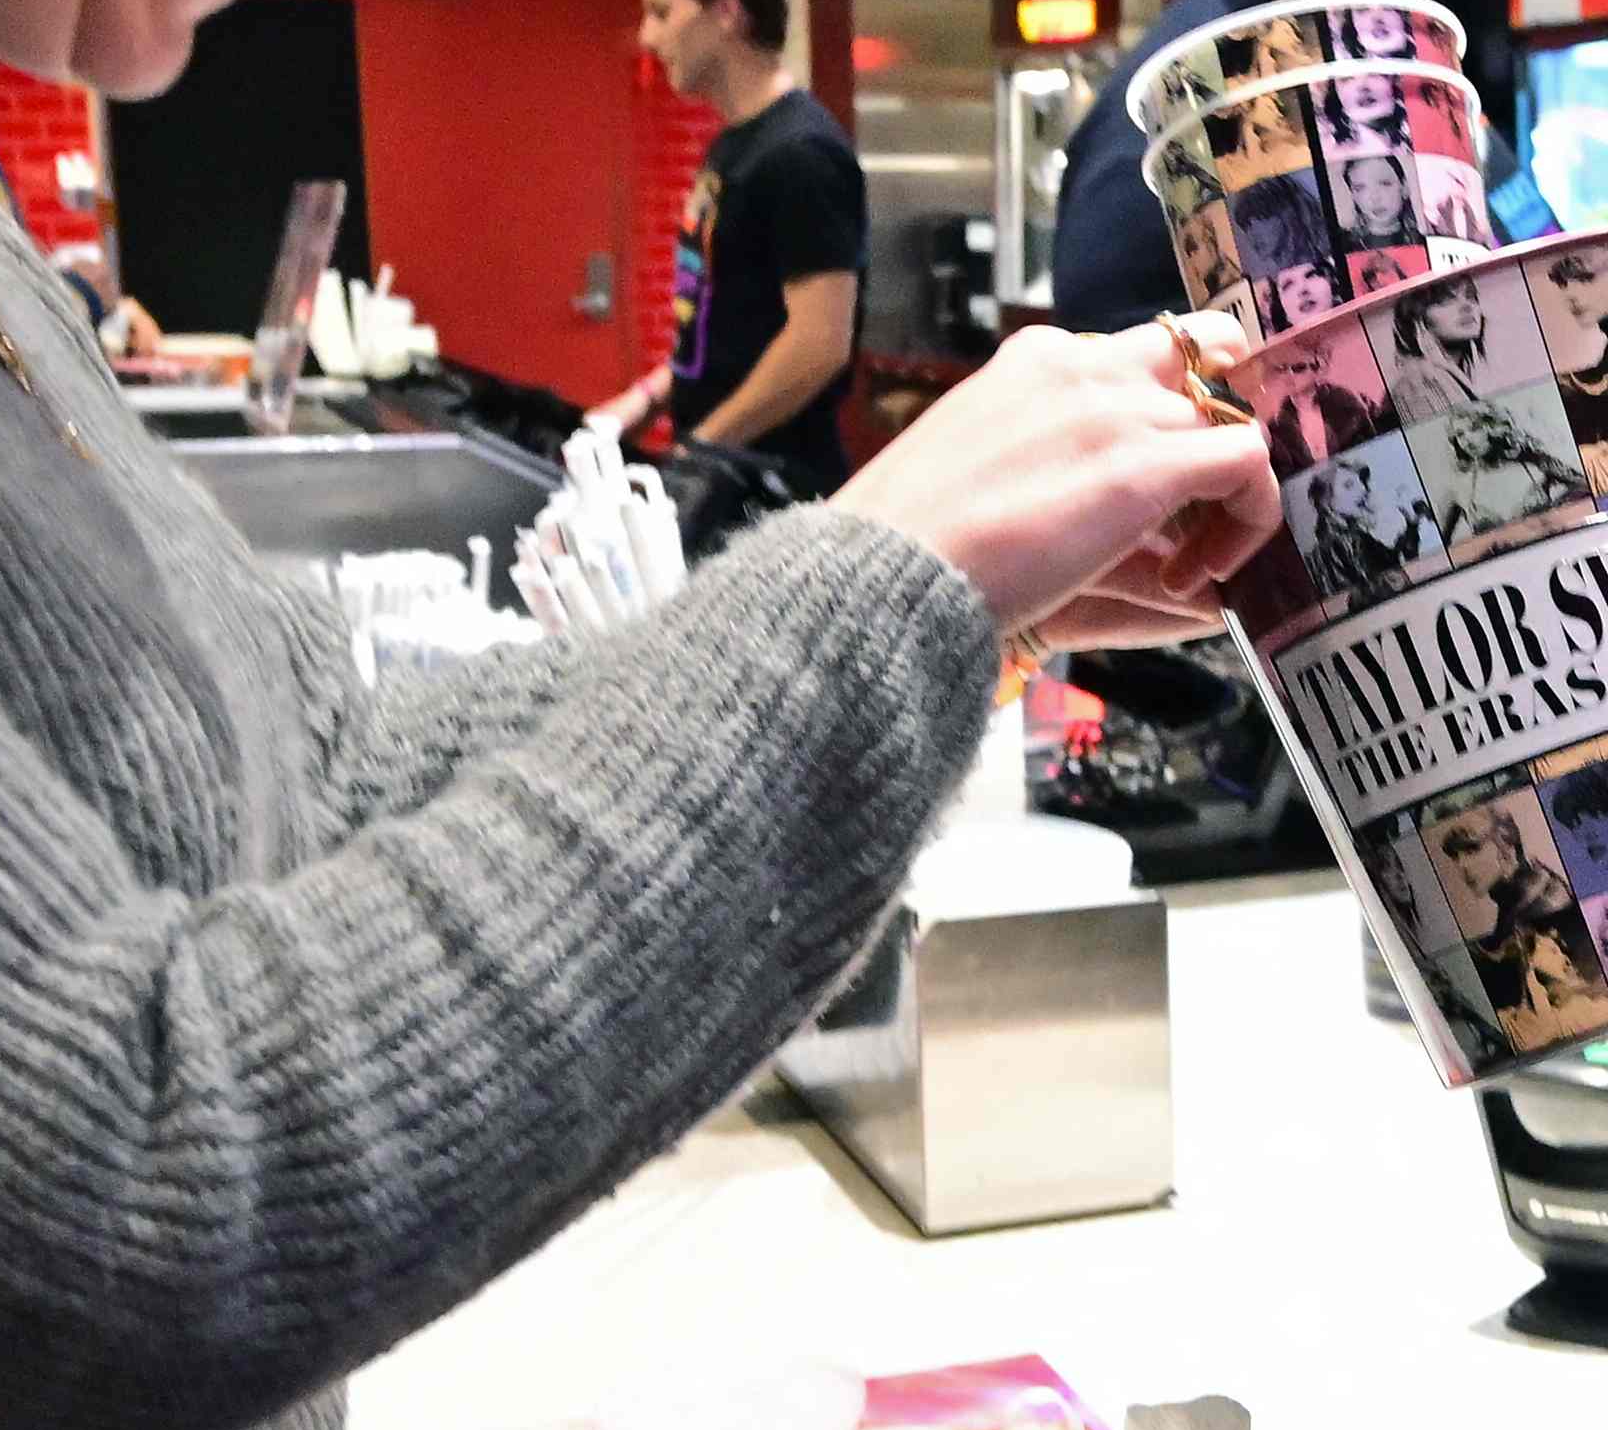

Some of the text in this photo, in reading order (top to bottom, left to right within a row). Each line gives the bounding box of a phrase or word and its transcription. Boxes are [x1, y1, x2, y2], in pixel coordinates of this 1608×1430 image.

[1295, 582, 1550, 753] TAYLOR
[1335, 720, 1439, 798] THE
[1445, 662, 1608, 758] ERAS
